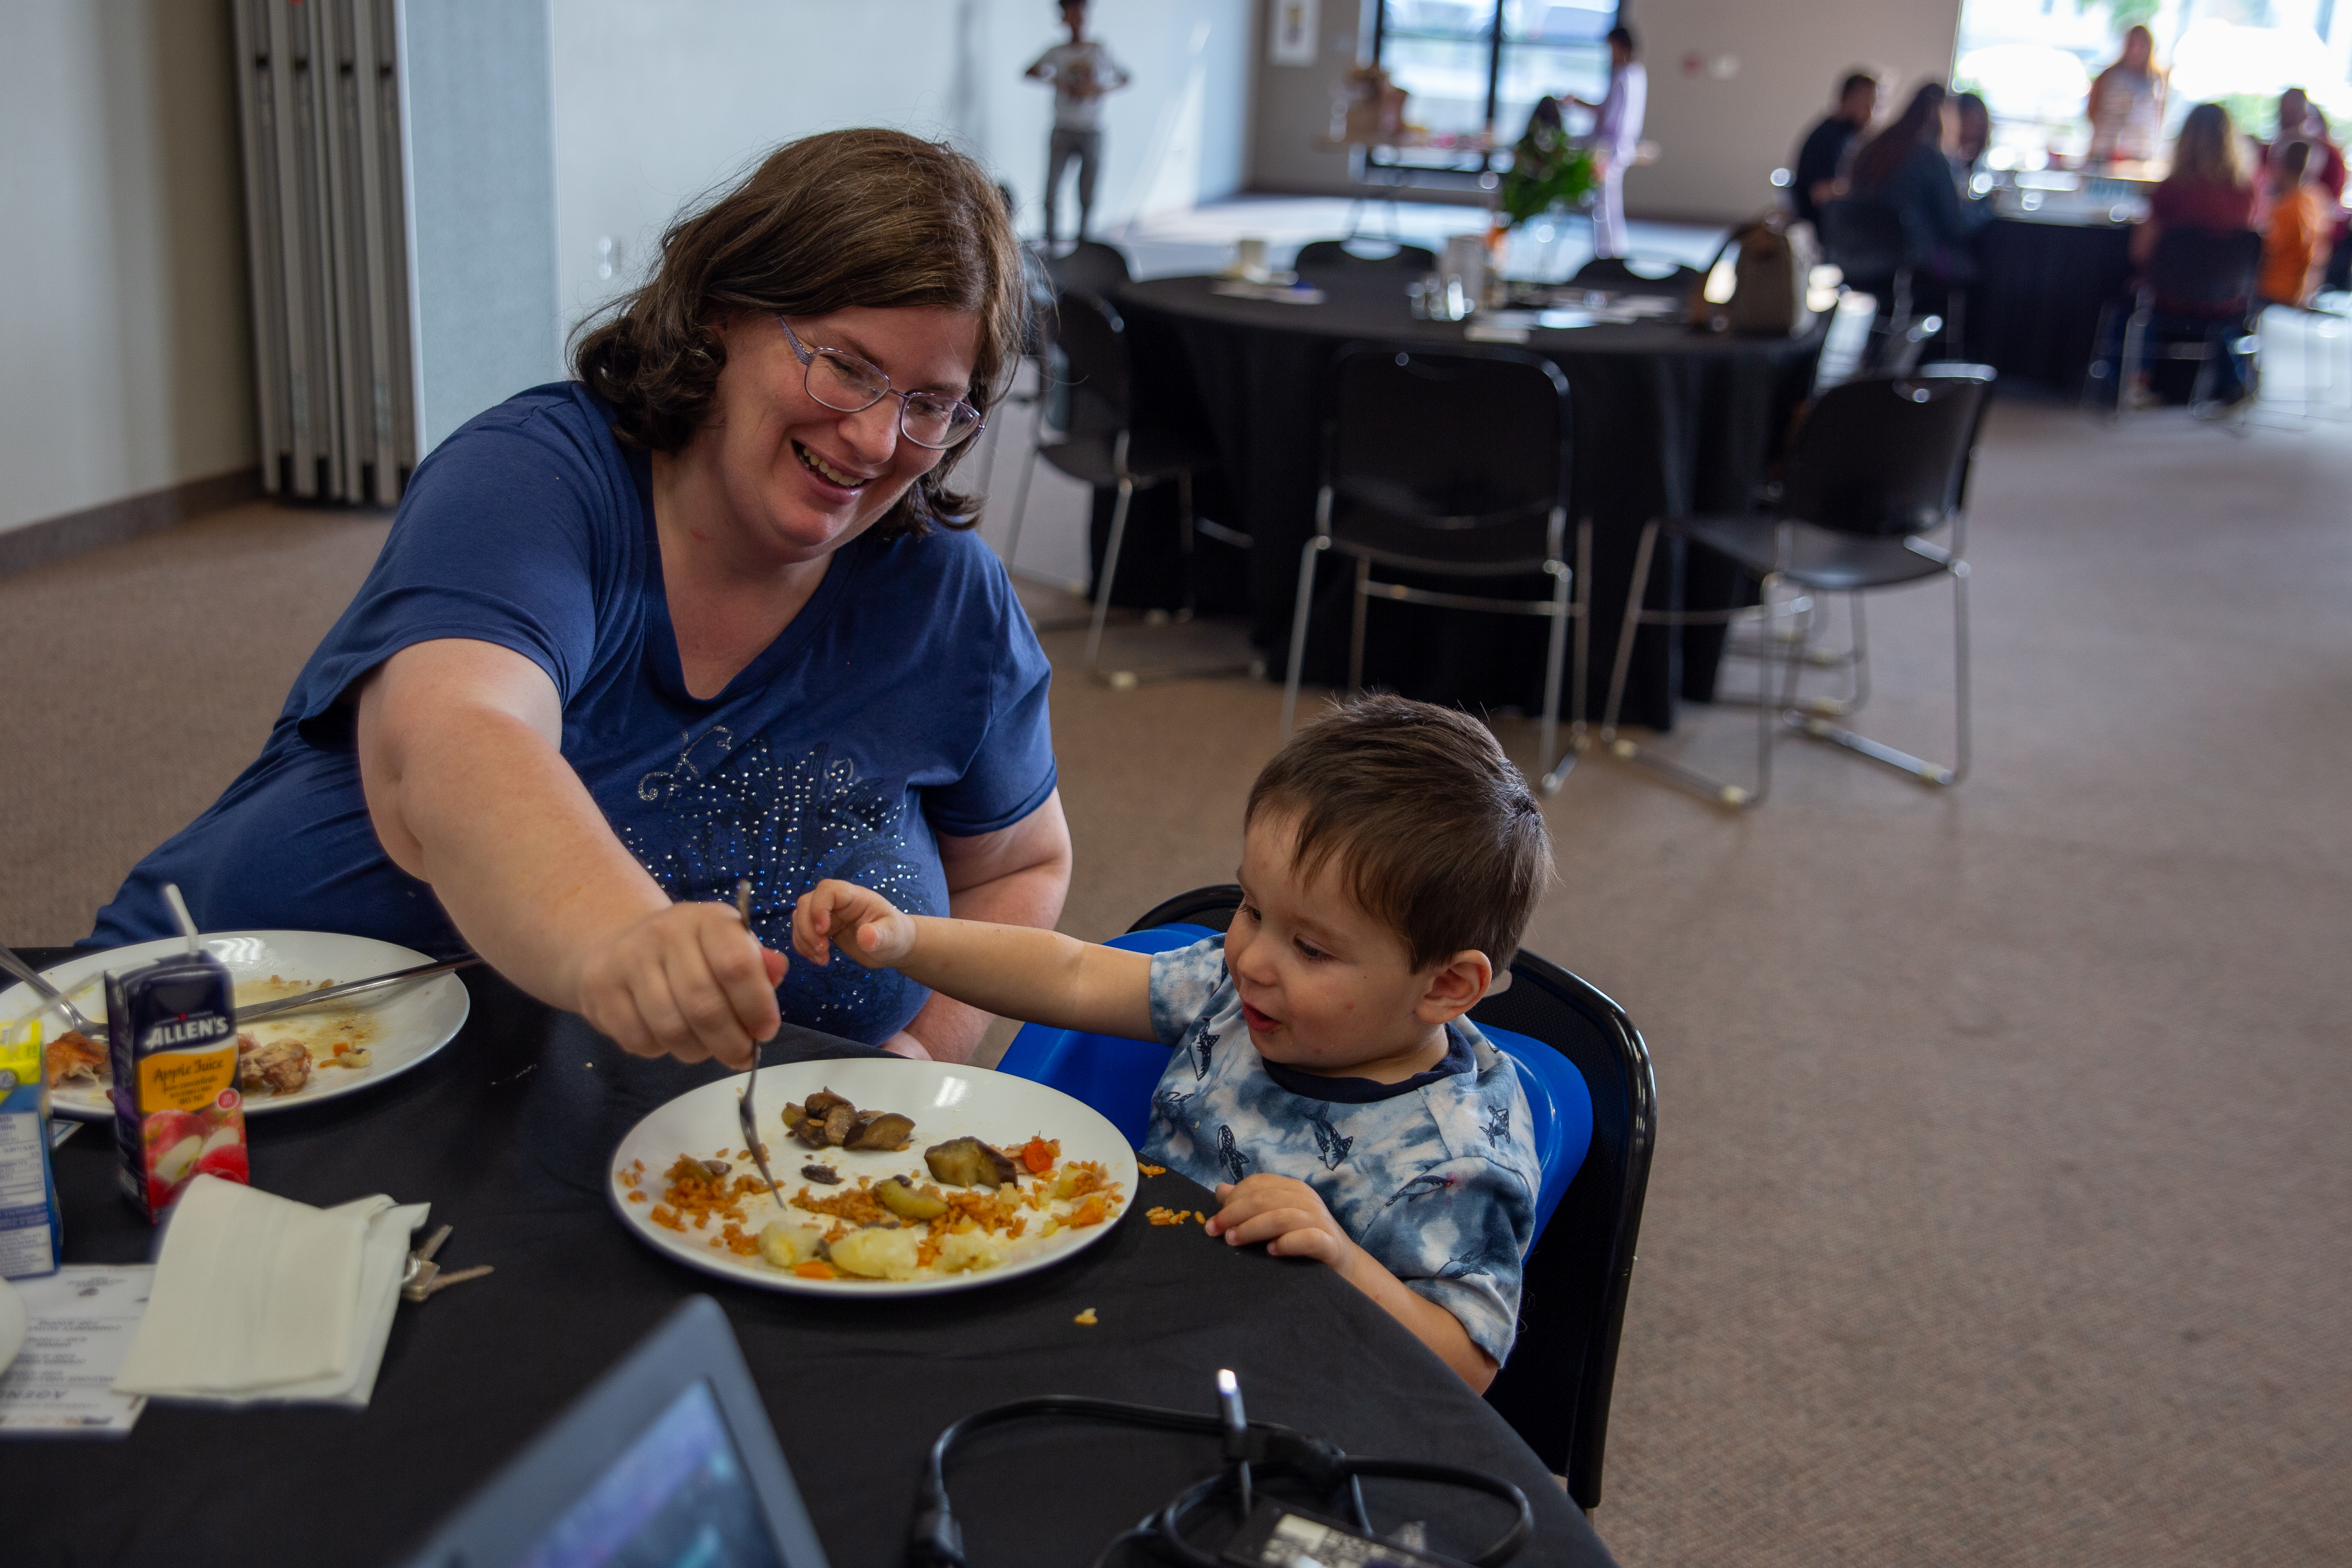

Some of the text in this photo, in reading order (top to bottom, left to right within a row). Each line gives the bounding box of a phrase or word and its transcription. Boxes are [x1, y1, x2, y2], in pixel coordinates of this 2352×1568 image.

[145, 1016, 229, 1049] ALLEN'S
[153, 1057, 224, 1085] Apple Juice
[180, 1075, 218, 1088] concentrate
